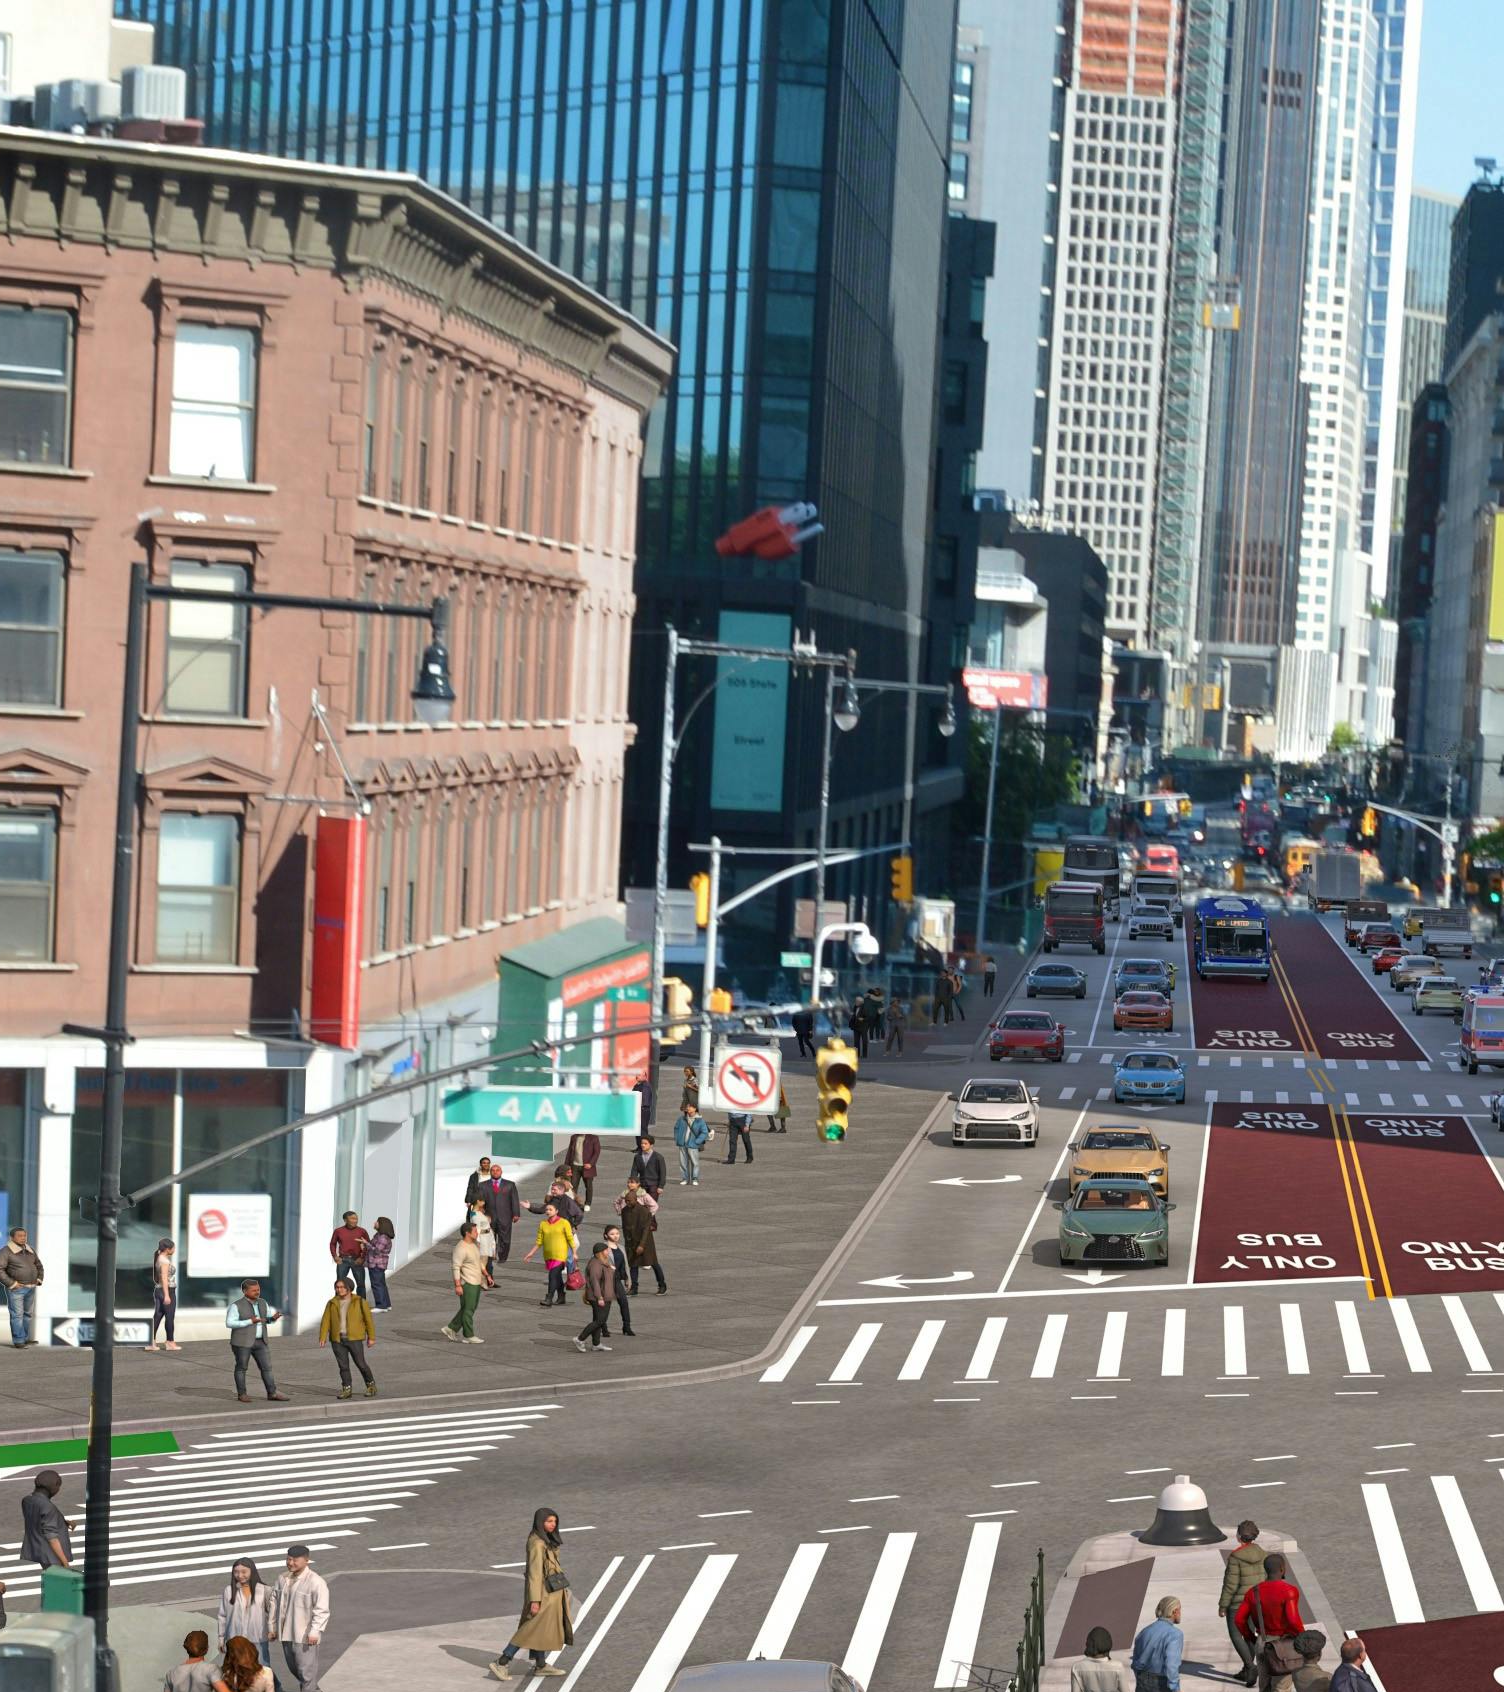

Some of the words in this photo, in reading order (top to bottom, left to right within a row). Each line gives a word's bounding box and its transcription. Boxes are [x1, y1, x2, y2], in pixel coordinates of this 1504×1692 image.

[1215, 1030, 1280, 1039] BUS
[1326, 1032, 1395, 1041] ONLY
[1207, 1038, 1292, 1047] ONLY
[1339, 1038, 1396, 1048] BUS
[498, 1097, 520, 1121] 4
[535, 1099, 581, 1123] Av
[1241, 1111, 1307, 1121] BUS
[1234, 1120, 1319, 1130] ONLY
[1365, 1118, 1446, 1129] ONLY
[1380, 1127, 1446, 1137] BUS
[1237, 1233, 1323, 1246] BUS
[1220, 1255, 1336, 1269] ONLY
[66, 1324, 96, 1339] ONE
